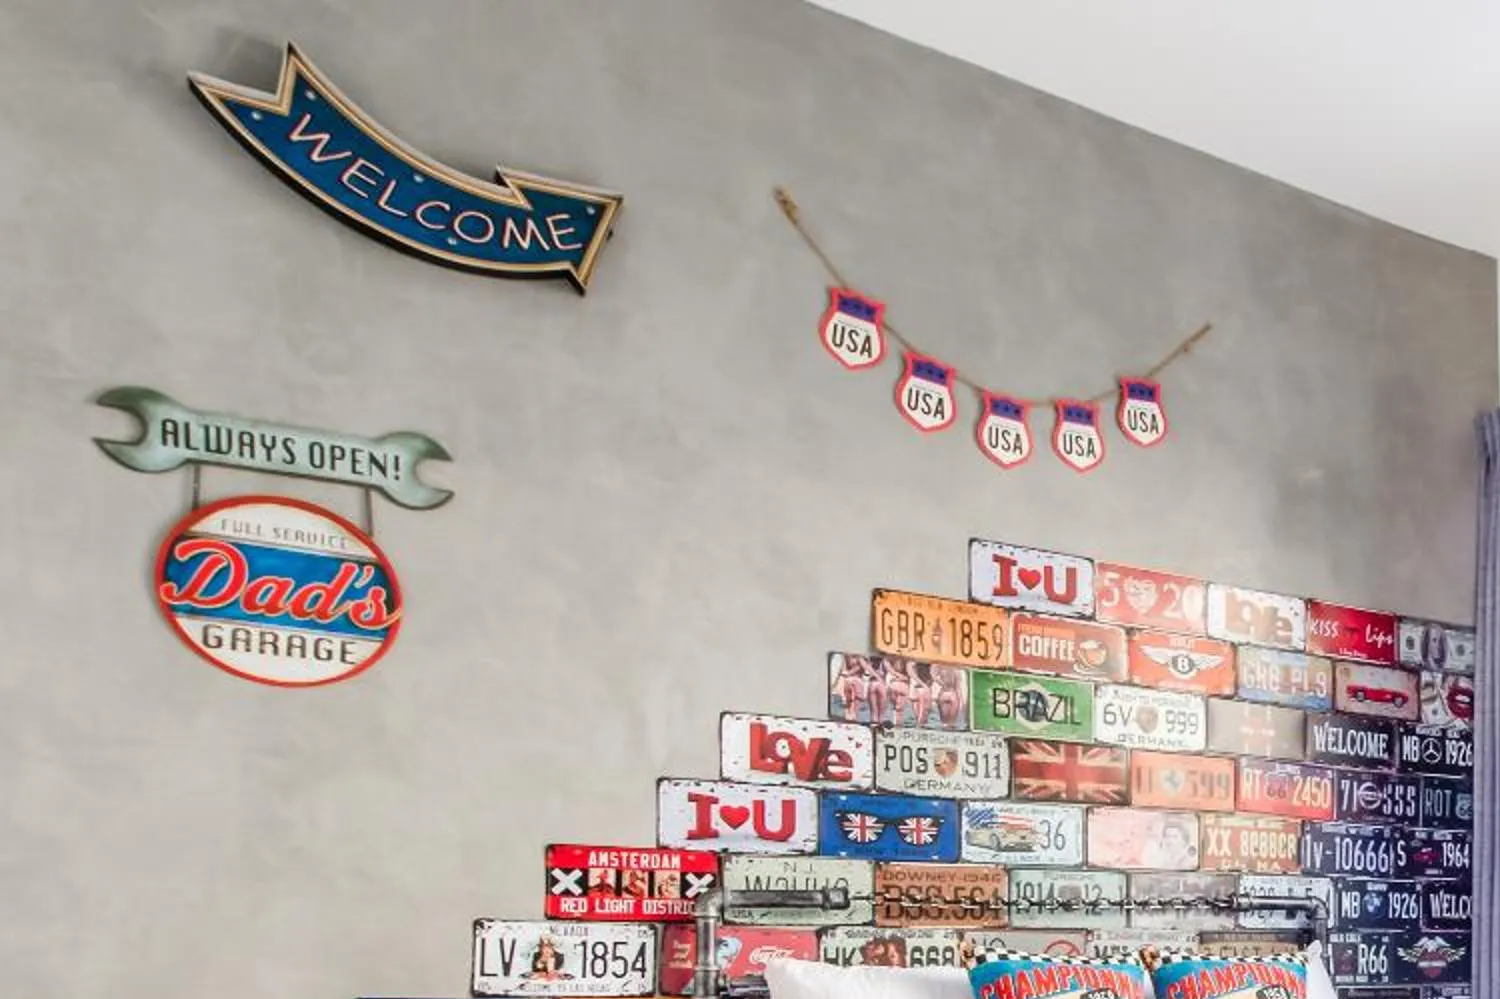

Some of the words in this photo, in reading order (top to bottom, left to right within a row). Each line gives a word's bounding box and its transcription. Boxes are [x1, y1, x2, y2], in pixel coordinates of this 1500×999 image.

[289, 112, 584, 253] WELCOME
[831, 323, 873, 358] USA
[907, 388, 945, 420] USA
[1127, 408, 1160, 436] USA
[160, 417, 297, 467] ALWAYS
[308, 441, 402, 481] OPEN!
[988, 425, 1024, 456] USA
[1063, 434, 1097, 459] USA
[220, 518, 263, 537] FULL
[159, 537, 402, 629] Dad's
[1043, 566, 1078, 604] U
[201, 623, 358, 667] GARAGE
[881, 607, 926, 652] GBR
[947, 617, 1004, 661] 1859
[1018, 634, 1076, 661] COFFEE
[992, 687, 1083, 726] BRAZIL
[1313, 721, 1389, 760] WELCOME
[884, 743, 929, 775] POS
[964, 751, 1002, 779] 911
[1291, 774, 1332, 809] 2450
[753, 799, 797, 842] U
[1039, 817, 1067, 851] 36
[588, 850, 681, 869] AMSTERDAM
[560, 897, 588, 913] RED
[594, 898, 636, 914] LIGHT
[642, 899, 696, 915] DISTRIC
[1387, 891, 1418, 919] 1926
[480, 938, 517, 977] LV
[579, 940, 647, 980] 1854
[1358, 943, 1389, 975] R66
